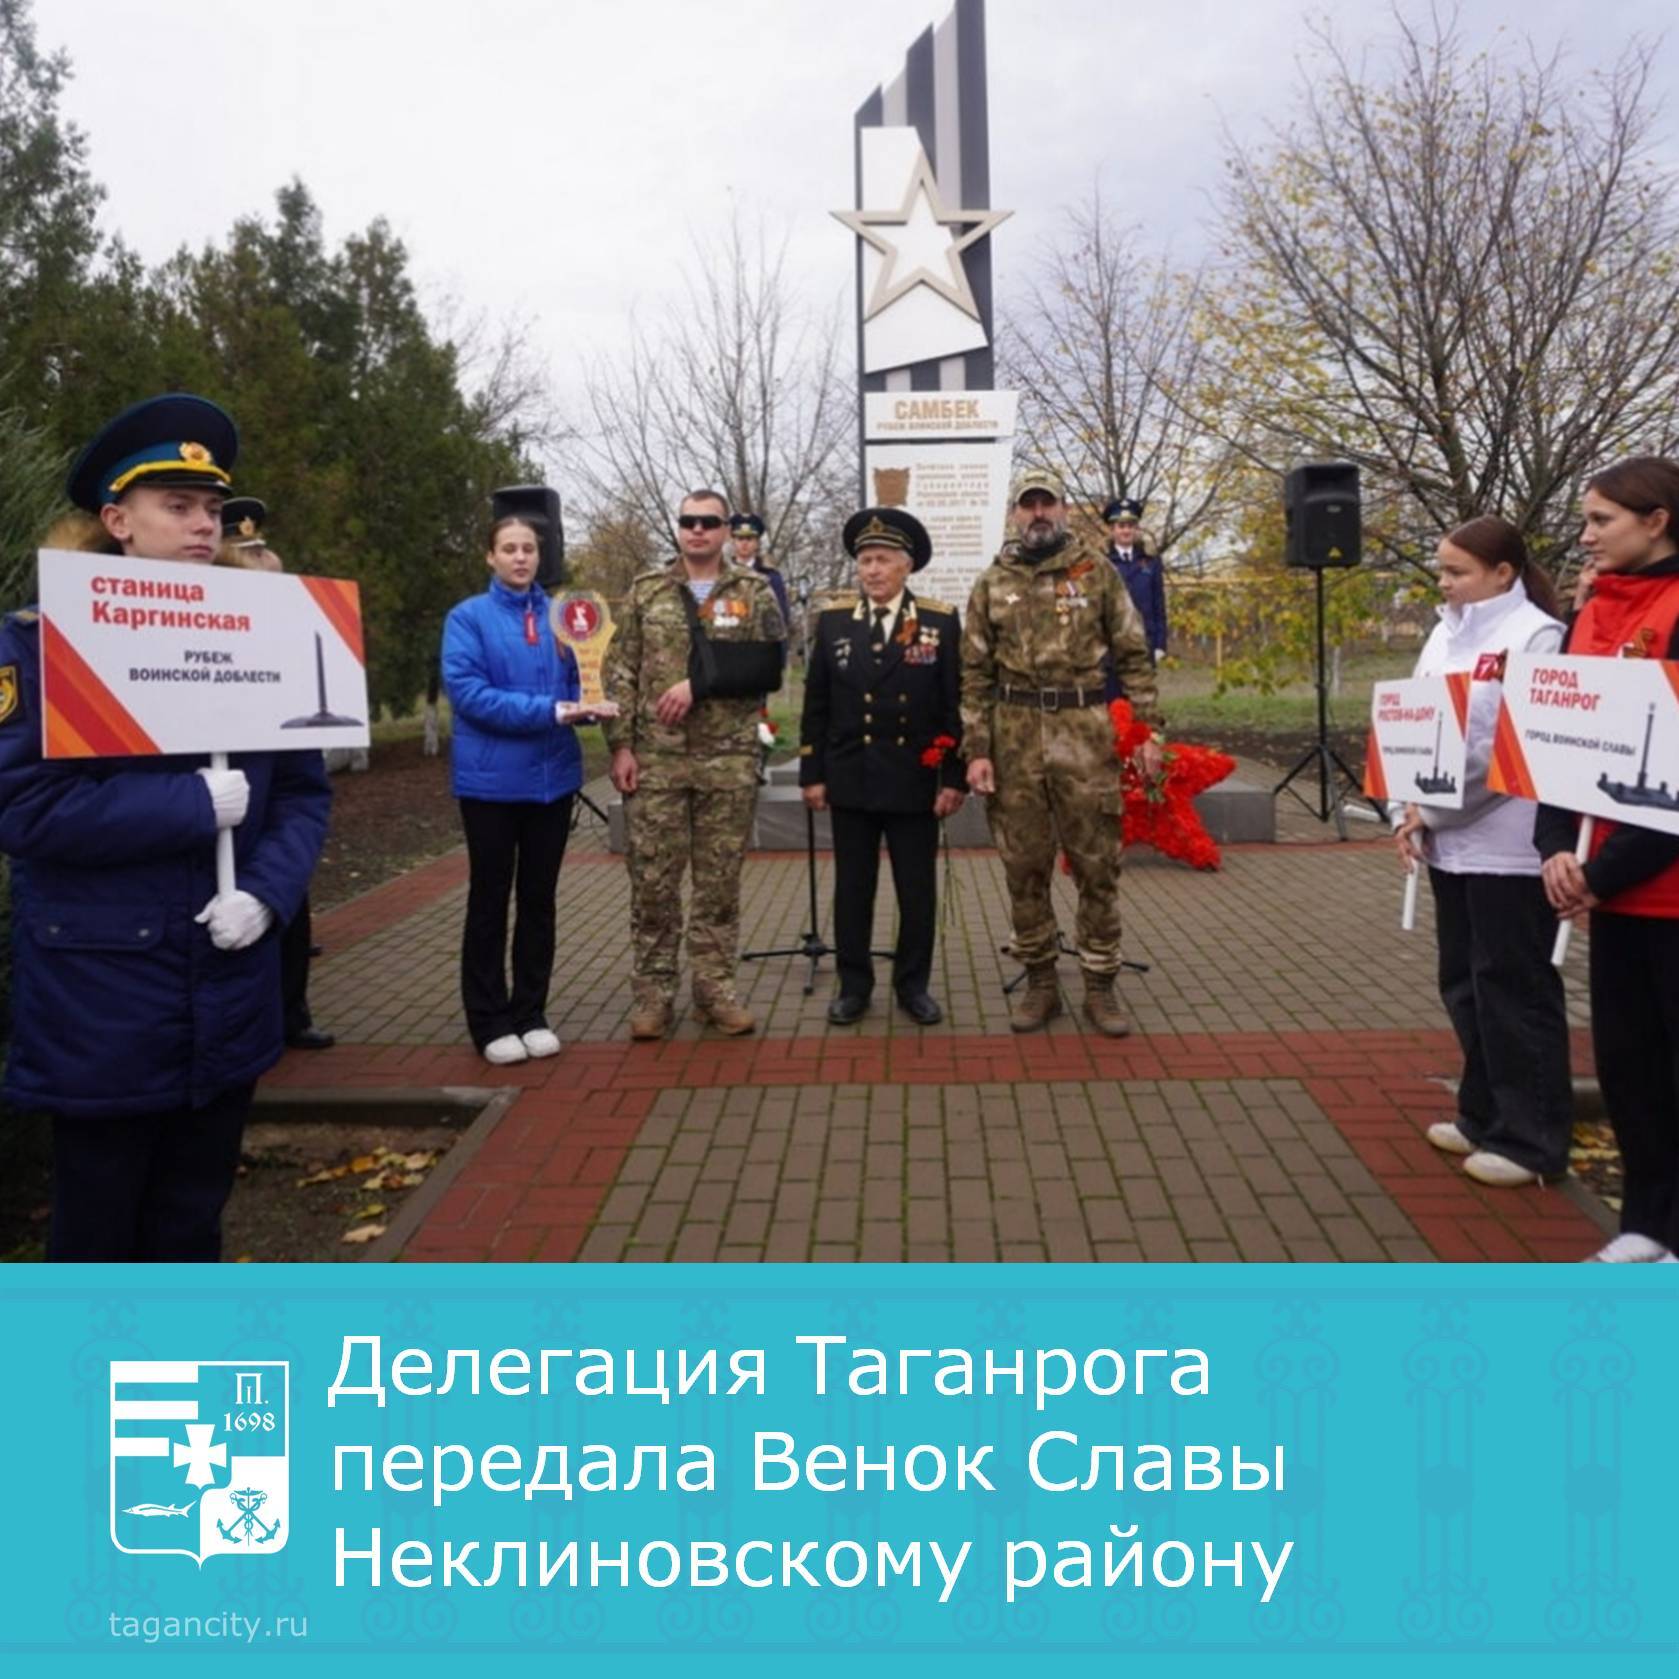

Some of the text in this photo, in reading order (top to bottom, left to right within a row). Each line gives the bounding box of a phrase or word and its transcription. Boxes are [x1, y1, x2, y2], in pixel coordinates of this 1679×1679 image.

[894, 400, 980, 420] САМБЕК
[90, 575, 205, 603] станица
[91, 600, 251, 632] Каргинская
[184, 650, 233, 664] РУБЕЖ
[129, 667, 281, 684] ВОИНСКОЙ ДОБЛЕСТИ
[1532, 668, 1579, 689] ГОРОД
[1529, 687, 1600, 711] ТАГАНРОГ
[1525, 729, 1636, 756] ГОРОД ВОИНСКОЙ СЛАВЫ
